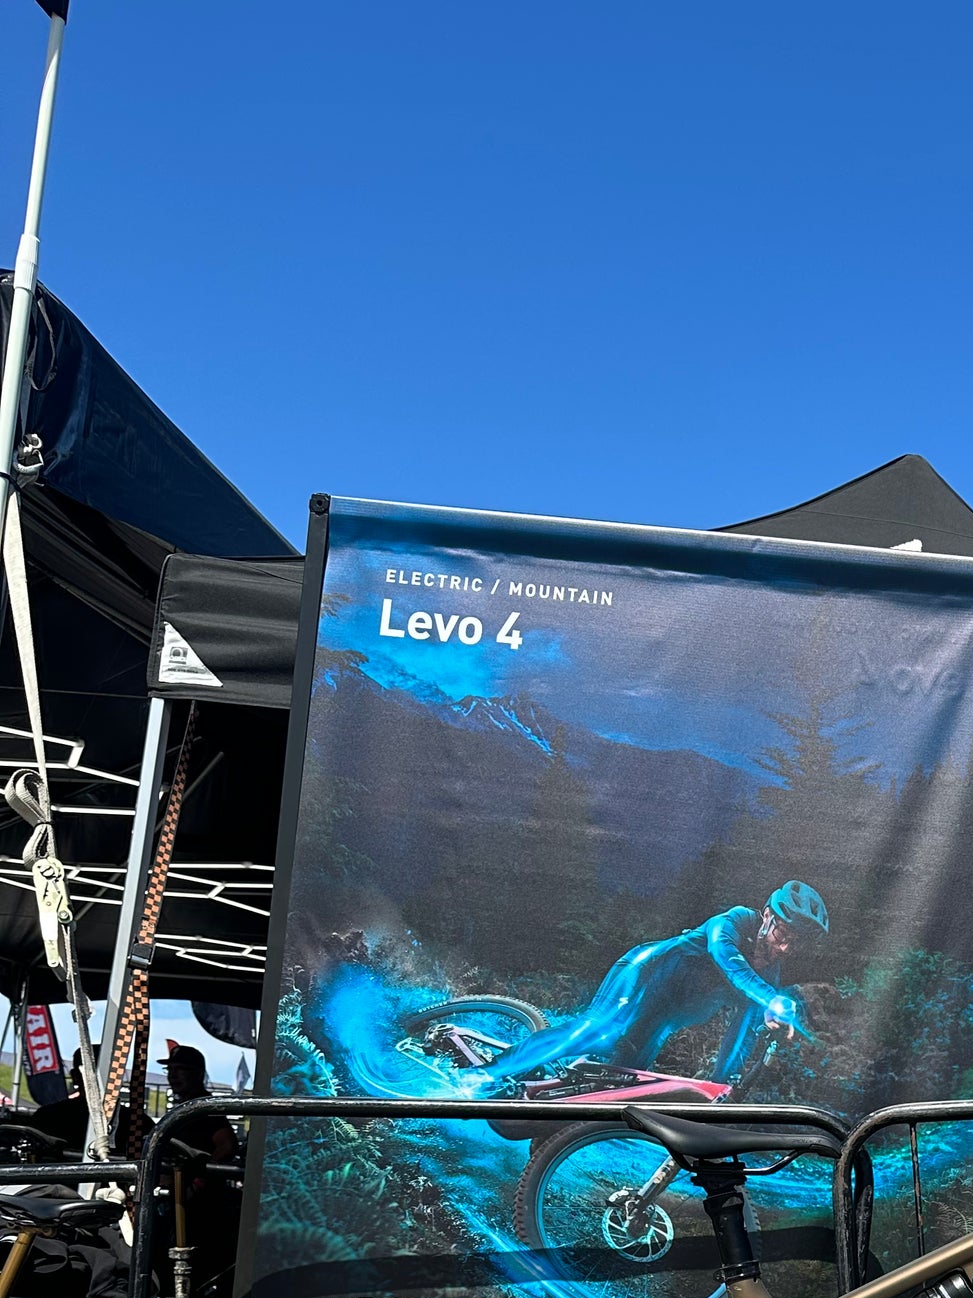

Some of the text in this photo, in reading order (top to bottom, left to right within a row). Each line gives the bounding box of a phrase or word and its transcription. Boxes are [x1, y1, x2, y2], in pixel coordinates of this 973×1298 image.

[385, 568, 614, 606] ELECTRIC / MOUNTAIN
[379, 598, 523, 650] Levo 4
